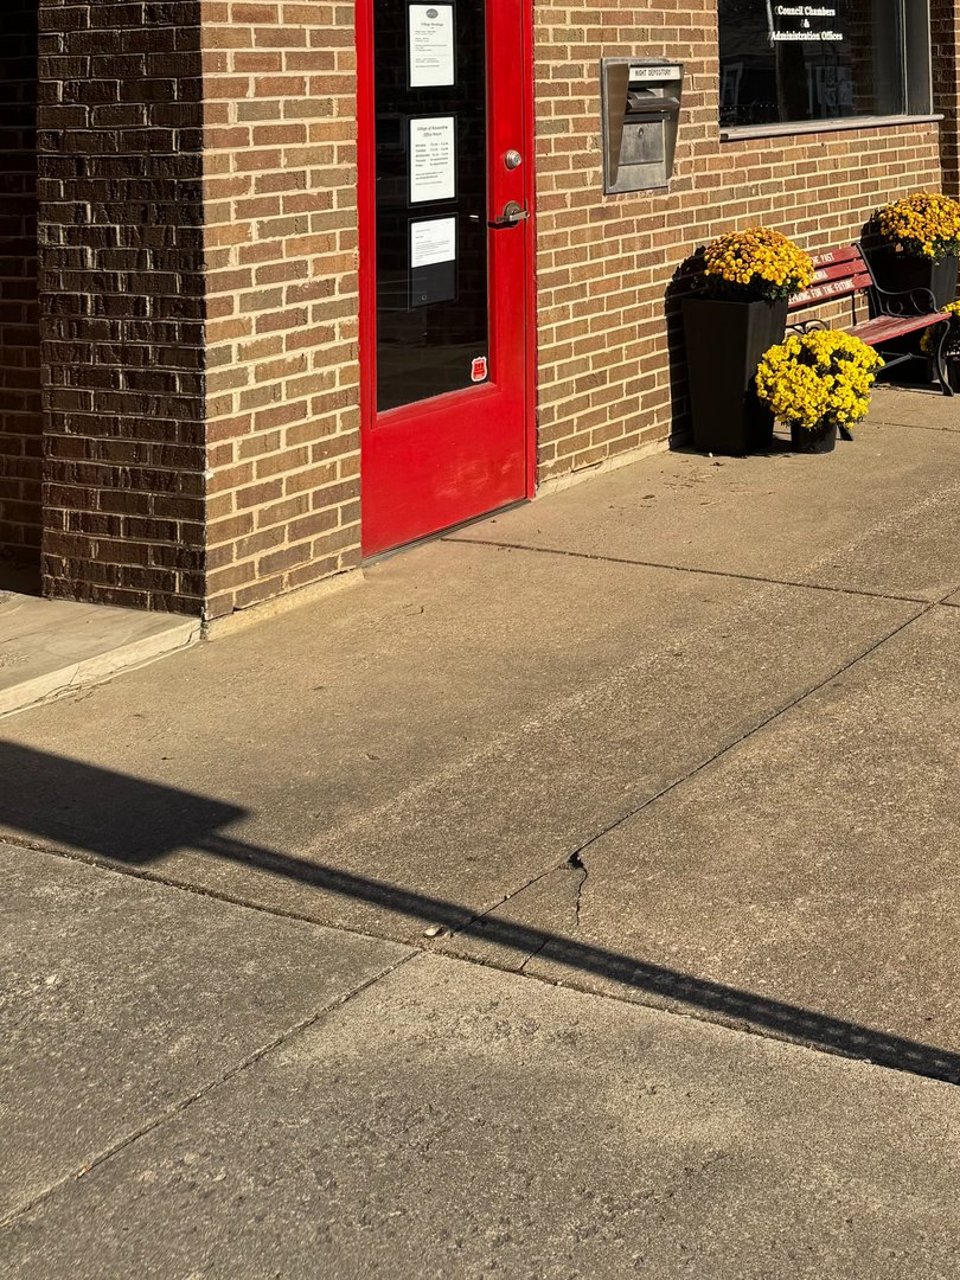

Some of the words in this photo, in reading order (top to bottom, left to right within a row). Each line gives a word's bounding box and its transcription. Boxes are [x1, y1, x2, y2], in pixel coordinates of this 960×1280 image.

[777, 5, 804, 16] Council
[804, 6, 836, 17] Chambers
[803, 18, 811, 28] &
[770, 30, 821, 41] Administration
[821, 30, 844, 41] Offices
[634, 69, 647, 77] NIGHT
[648, 69, 672, 77] DEPOSITORY
[811, 287, 823, 297] FOR
[834, 279, 856, 291] FUTURE
